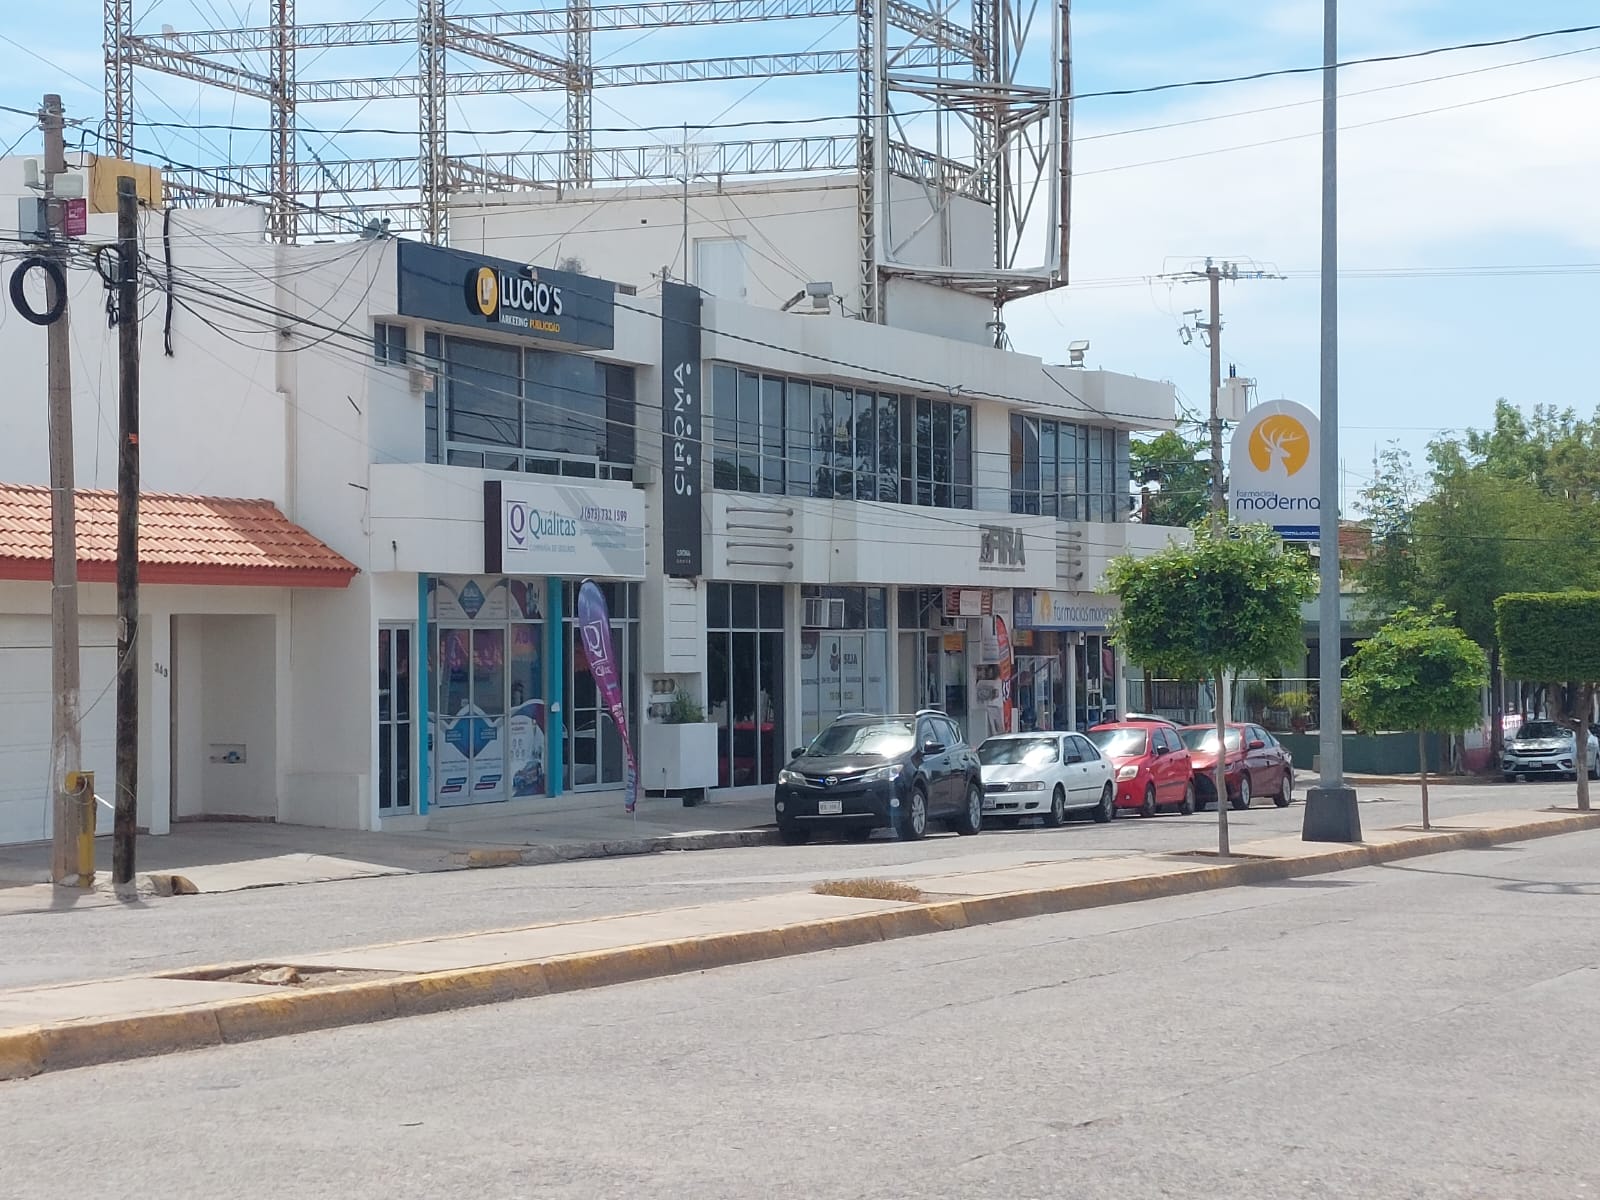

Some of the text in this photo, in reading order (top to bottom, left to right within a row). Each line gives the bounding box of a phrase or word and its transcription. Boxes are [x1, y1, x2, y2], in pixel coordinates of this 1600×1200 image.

[501, 275, 562, 316] LUCIO'S
[673, 362, 685, 495] CIROMA
[529, 509, 576, 540] Quálitas
[584, 506, 628, 522] (673) 732 1599
